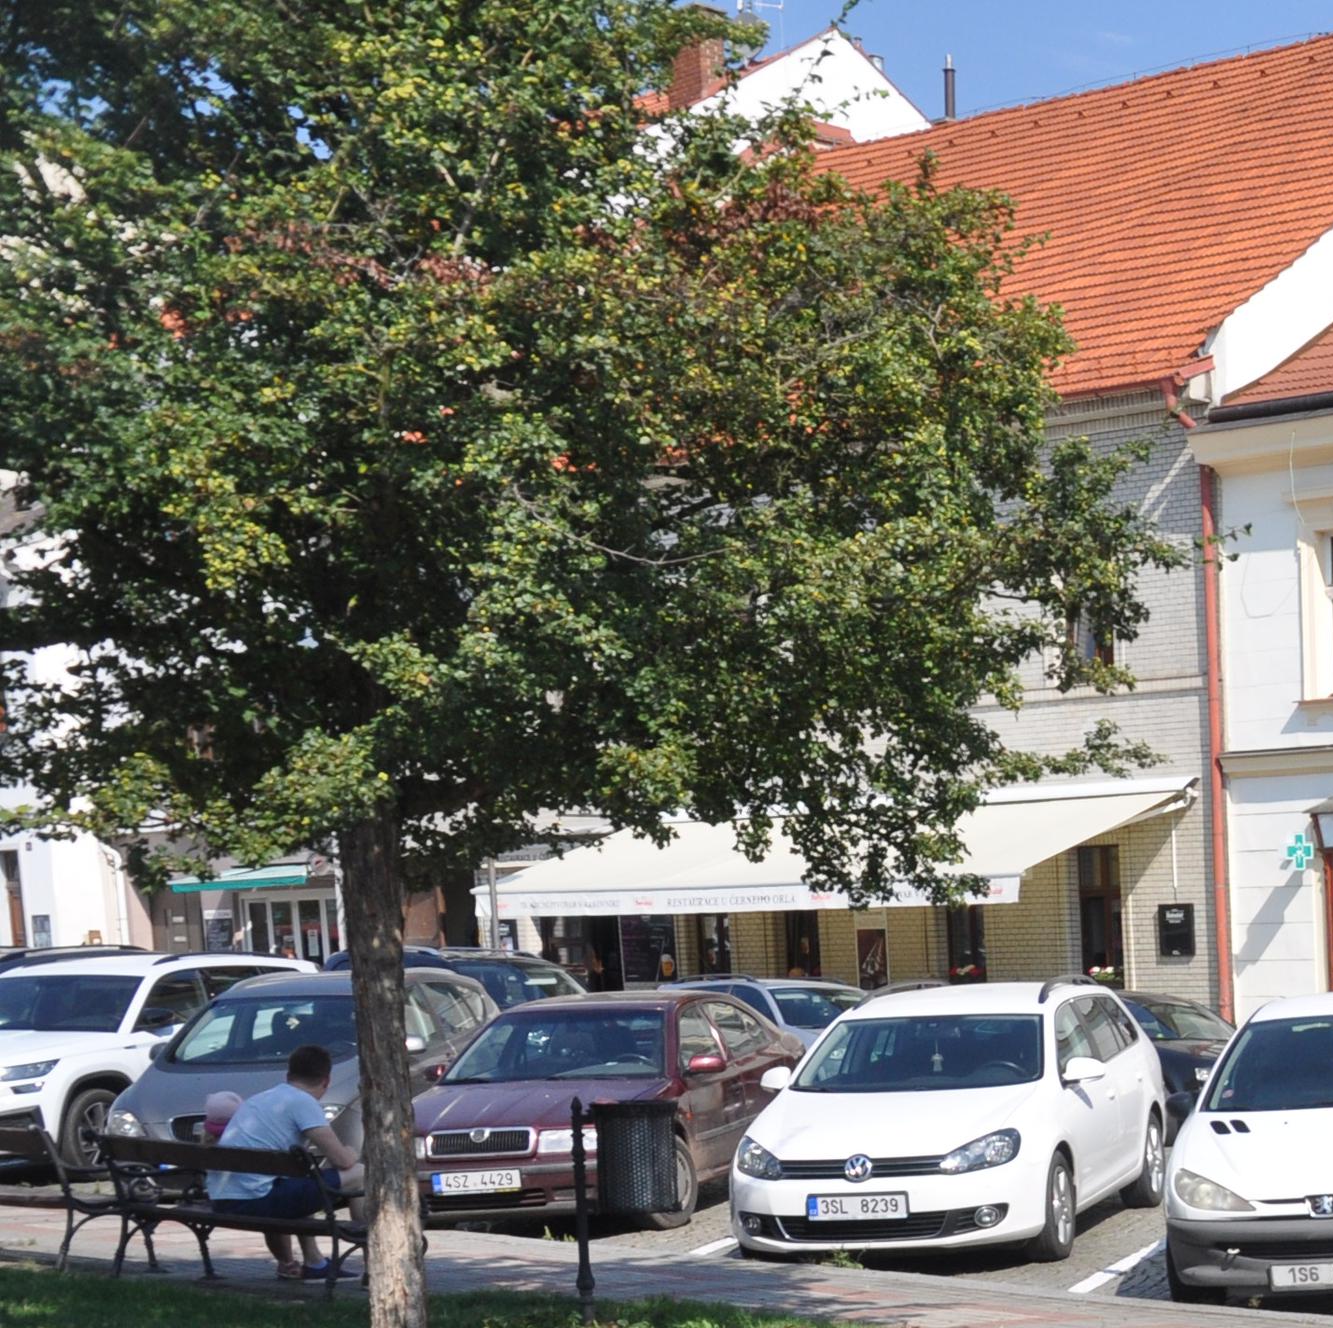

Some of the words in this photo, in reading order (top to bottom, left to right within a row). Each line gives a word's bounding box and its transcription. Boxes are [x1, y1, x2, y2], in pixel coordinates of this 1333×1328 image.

[445, 1174, 470, 1189] 4SZ
[481, 1172, 513, 1187] 4429
[821, 1199, 848, 1215] 3SL
[860, 1198, 898, 1214] 8239
[1288, 1266, 1319, 1283] 1S6
